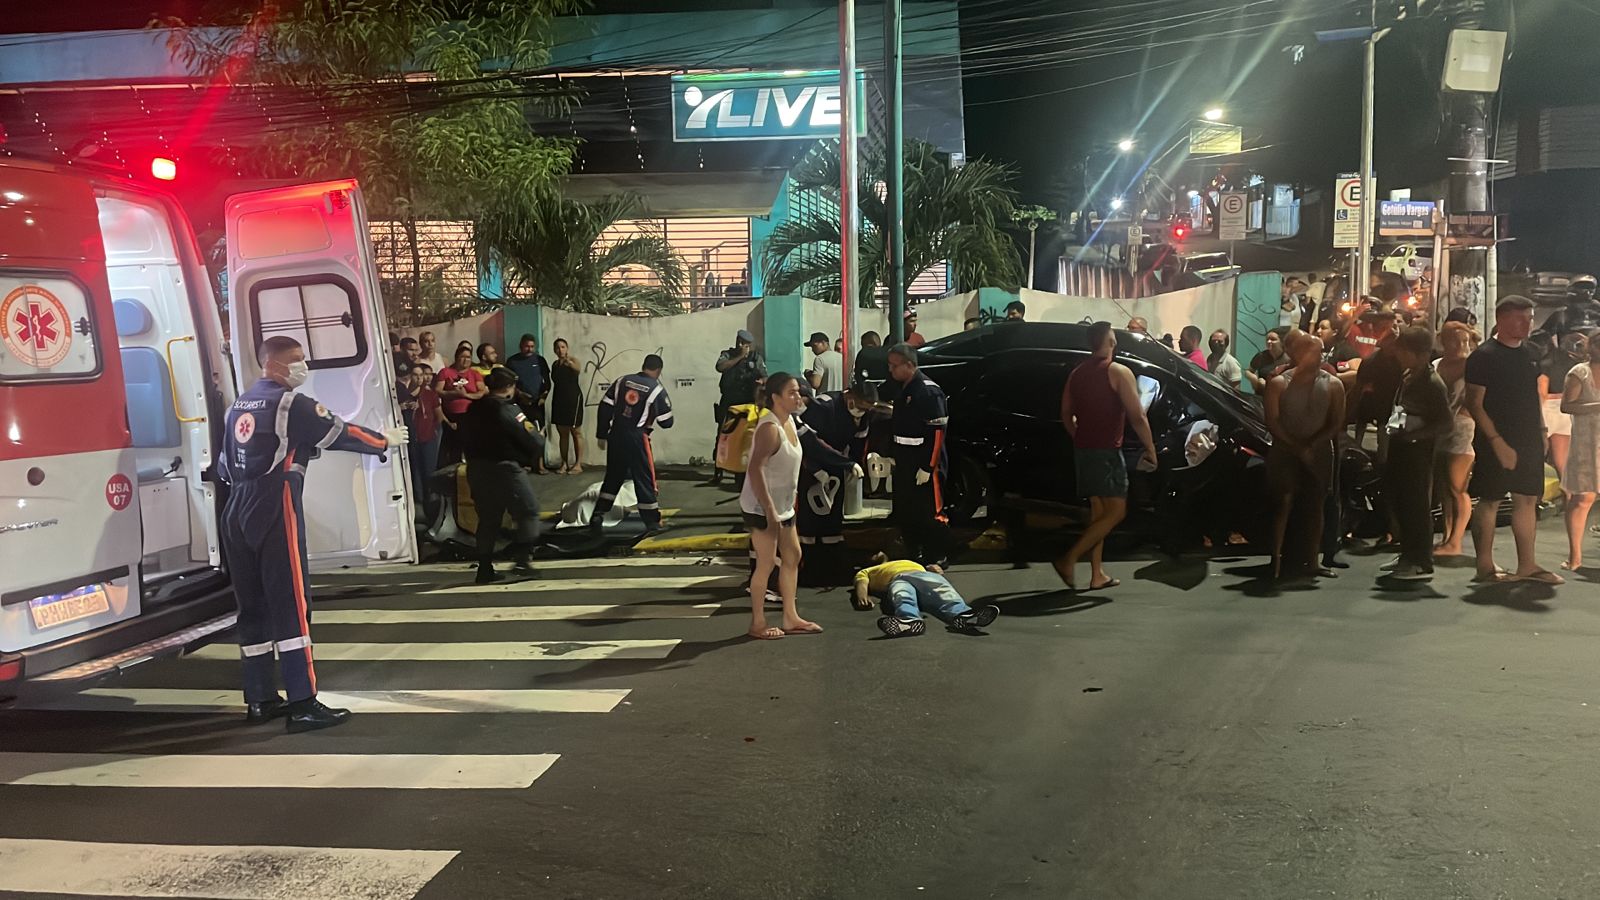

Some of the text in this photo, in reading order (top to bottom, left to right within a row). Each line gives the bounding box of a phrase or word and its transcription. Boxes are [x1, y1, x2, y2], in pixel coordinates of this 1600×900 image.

[717, 85, 841, 128] LIVE
[1350, 186, 1361, 201] E
[1229, 199, 1238, 210] E
[1406, 203, 1429, 217] Vargas
[108, 482, 130, 494] USA
[113, 494, 127, 506] 07
